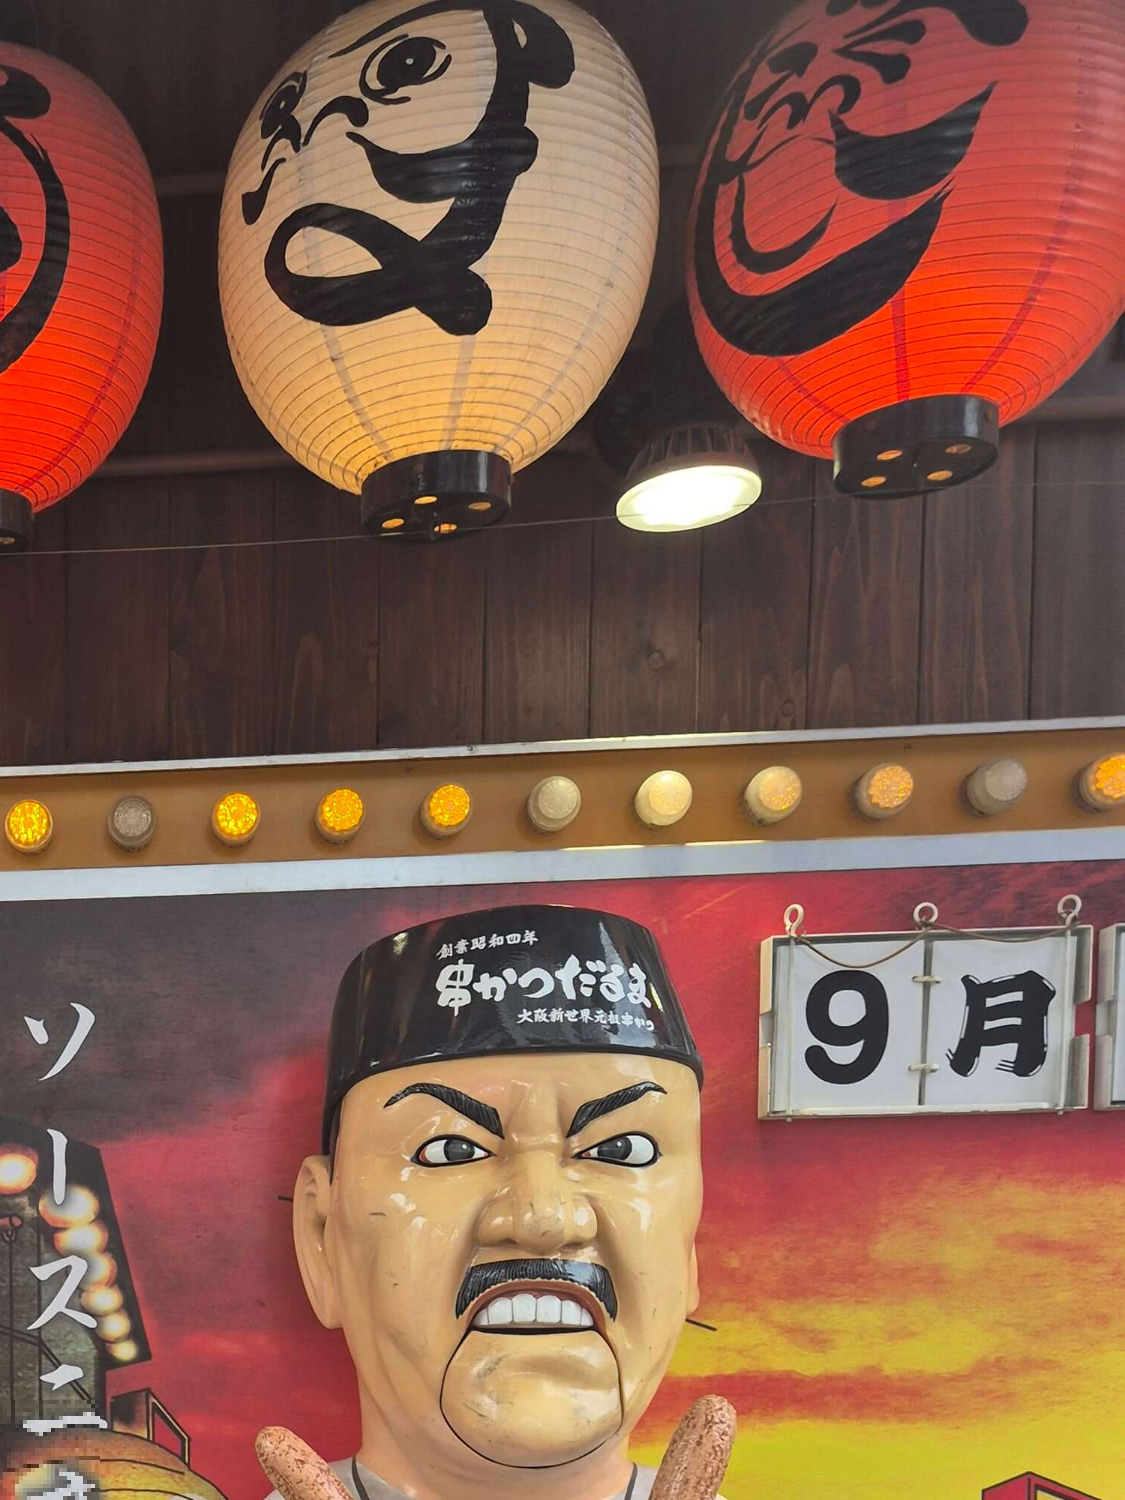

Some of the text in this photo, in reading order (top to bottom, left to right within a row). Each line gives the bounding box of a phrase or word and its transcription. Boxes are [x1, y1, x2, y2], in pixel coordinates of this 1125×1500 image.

[435, 928, 539, 961] 創業昭和四年
[435, 953, 653, 1018] 串かつだるま
